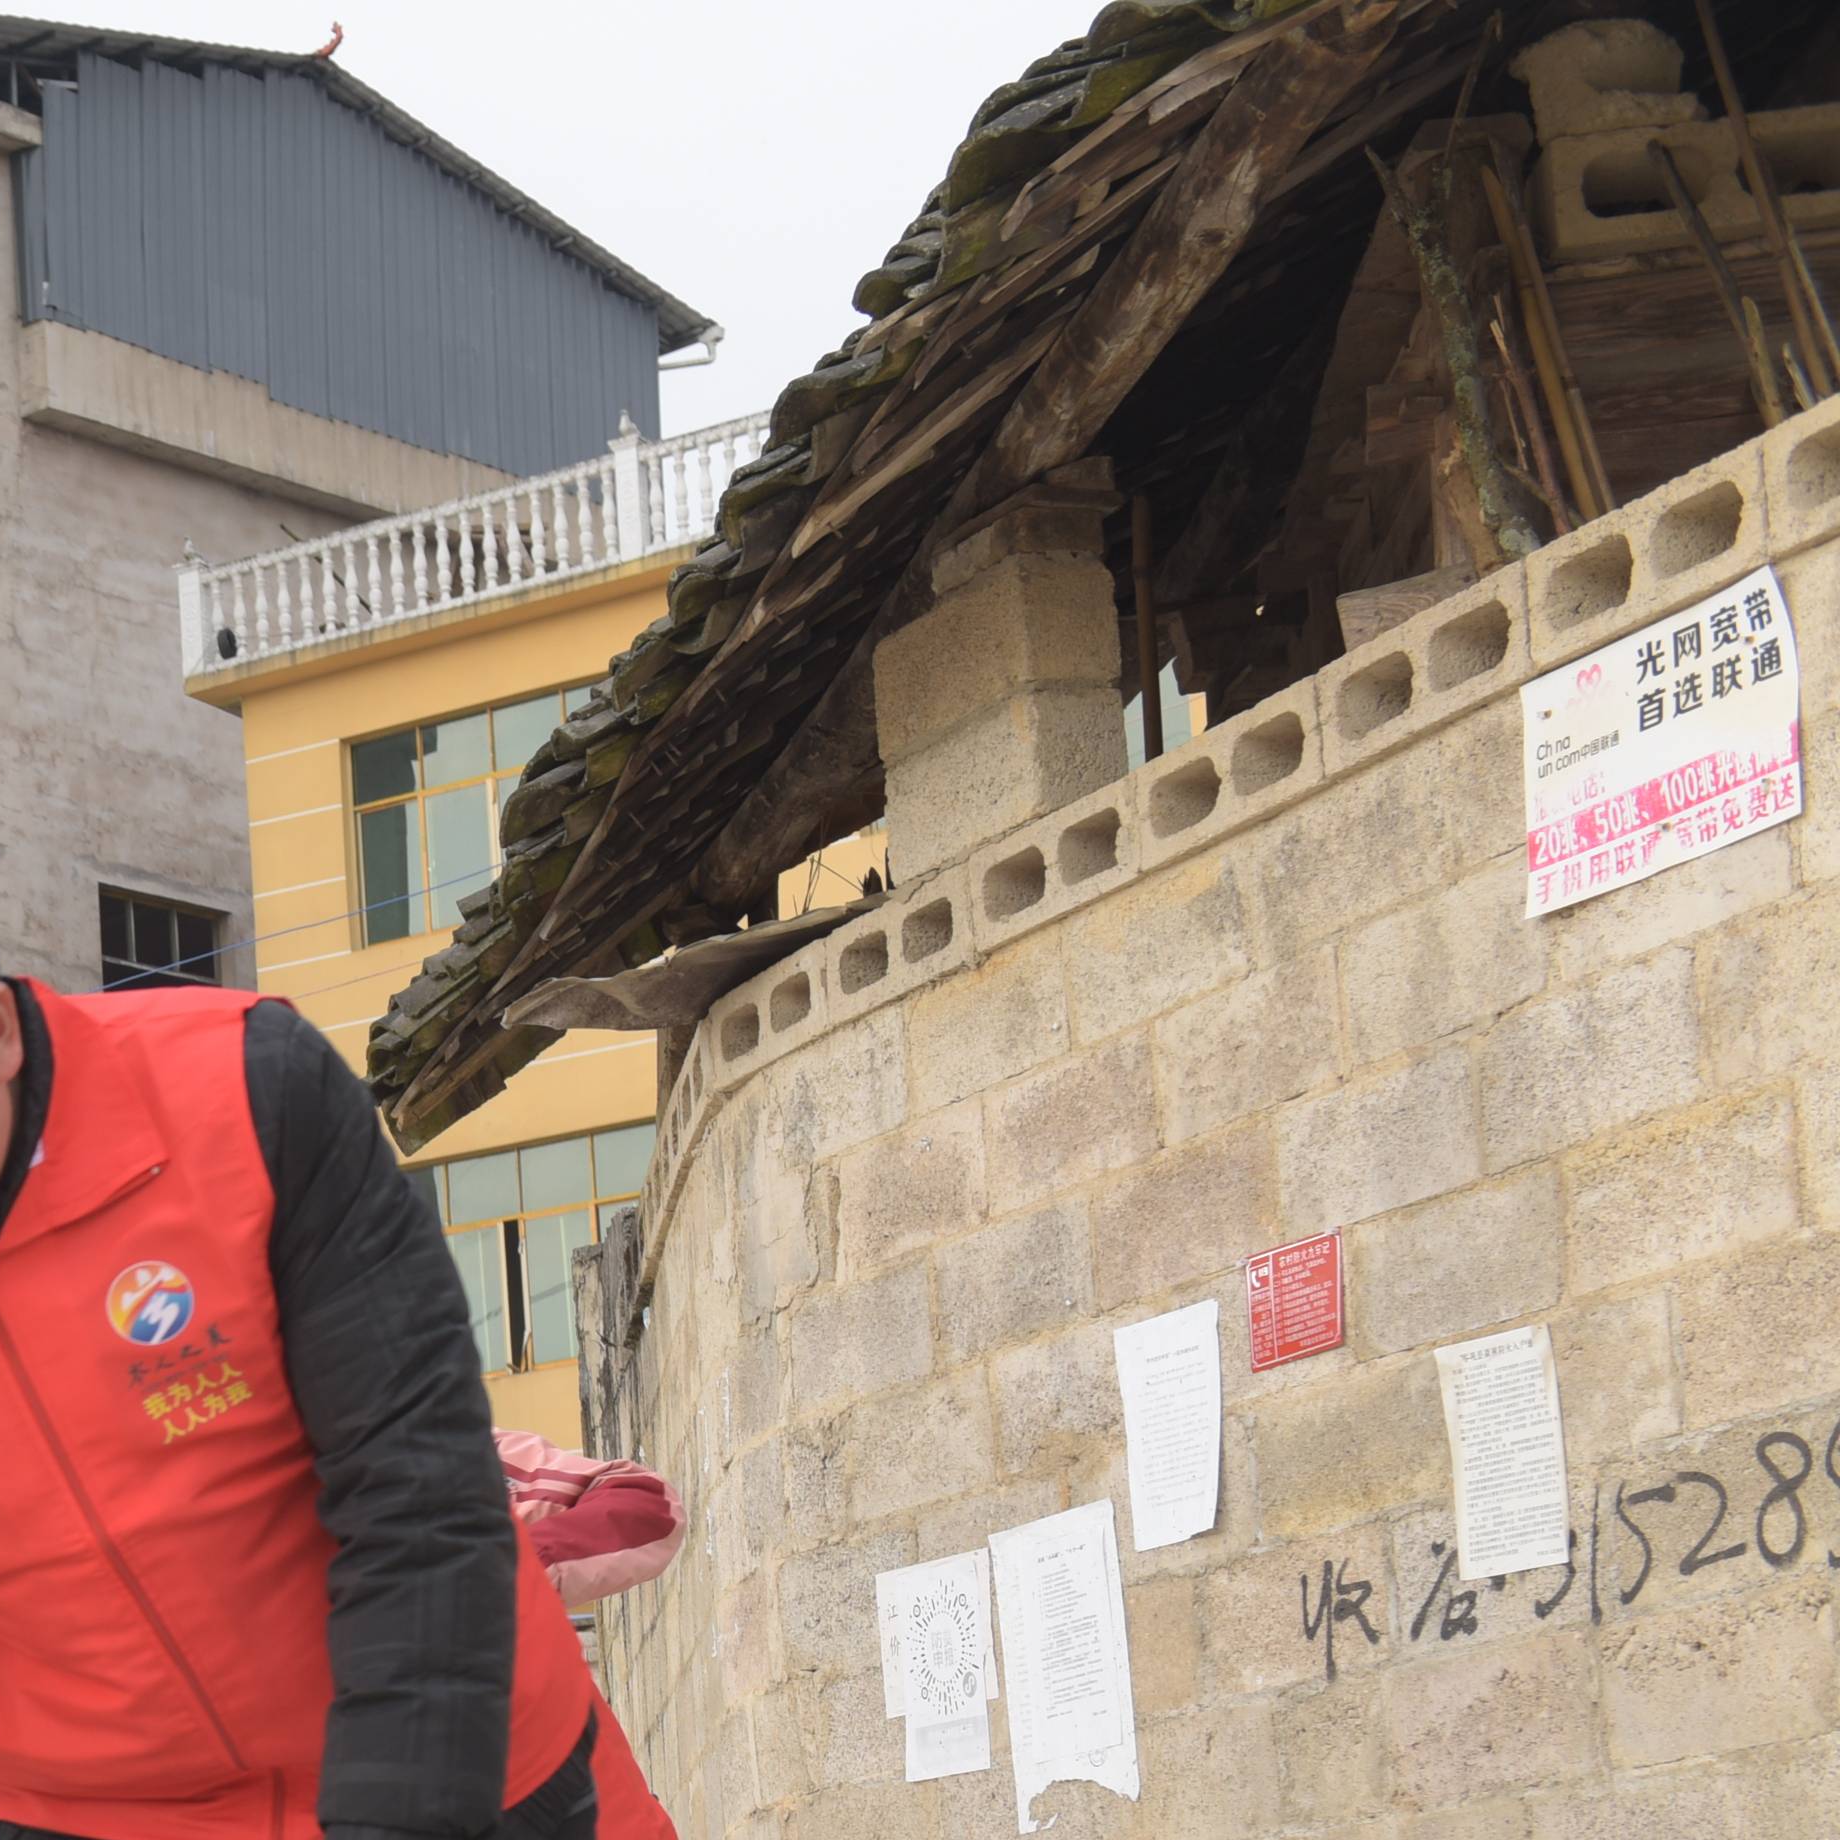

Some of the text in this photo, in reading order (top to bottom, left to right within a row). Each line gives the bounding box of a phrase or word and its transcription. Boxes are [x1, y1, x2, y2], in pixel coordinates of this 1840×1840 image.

[1636, 588, 1773, 683] 光网宽带
[1638, 637, 1782, 732] 首选联通
[1537, 736, 1571, 760] Chna
